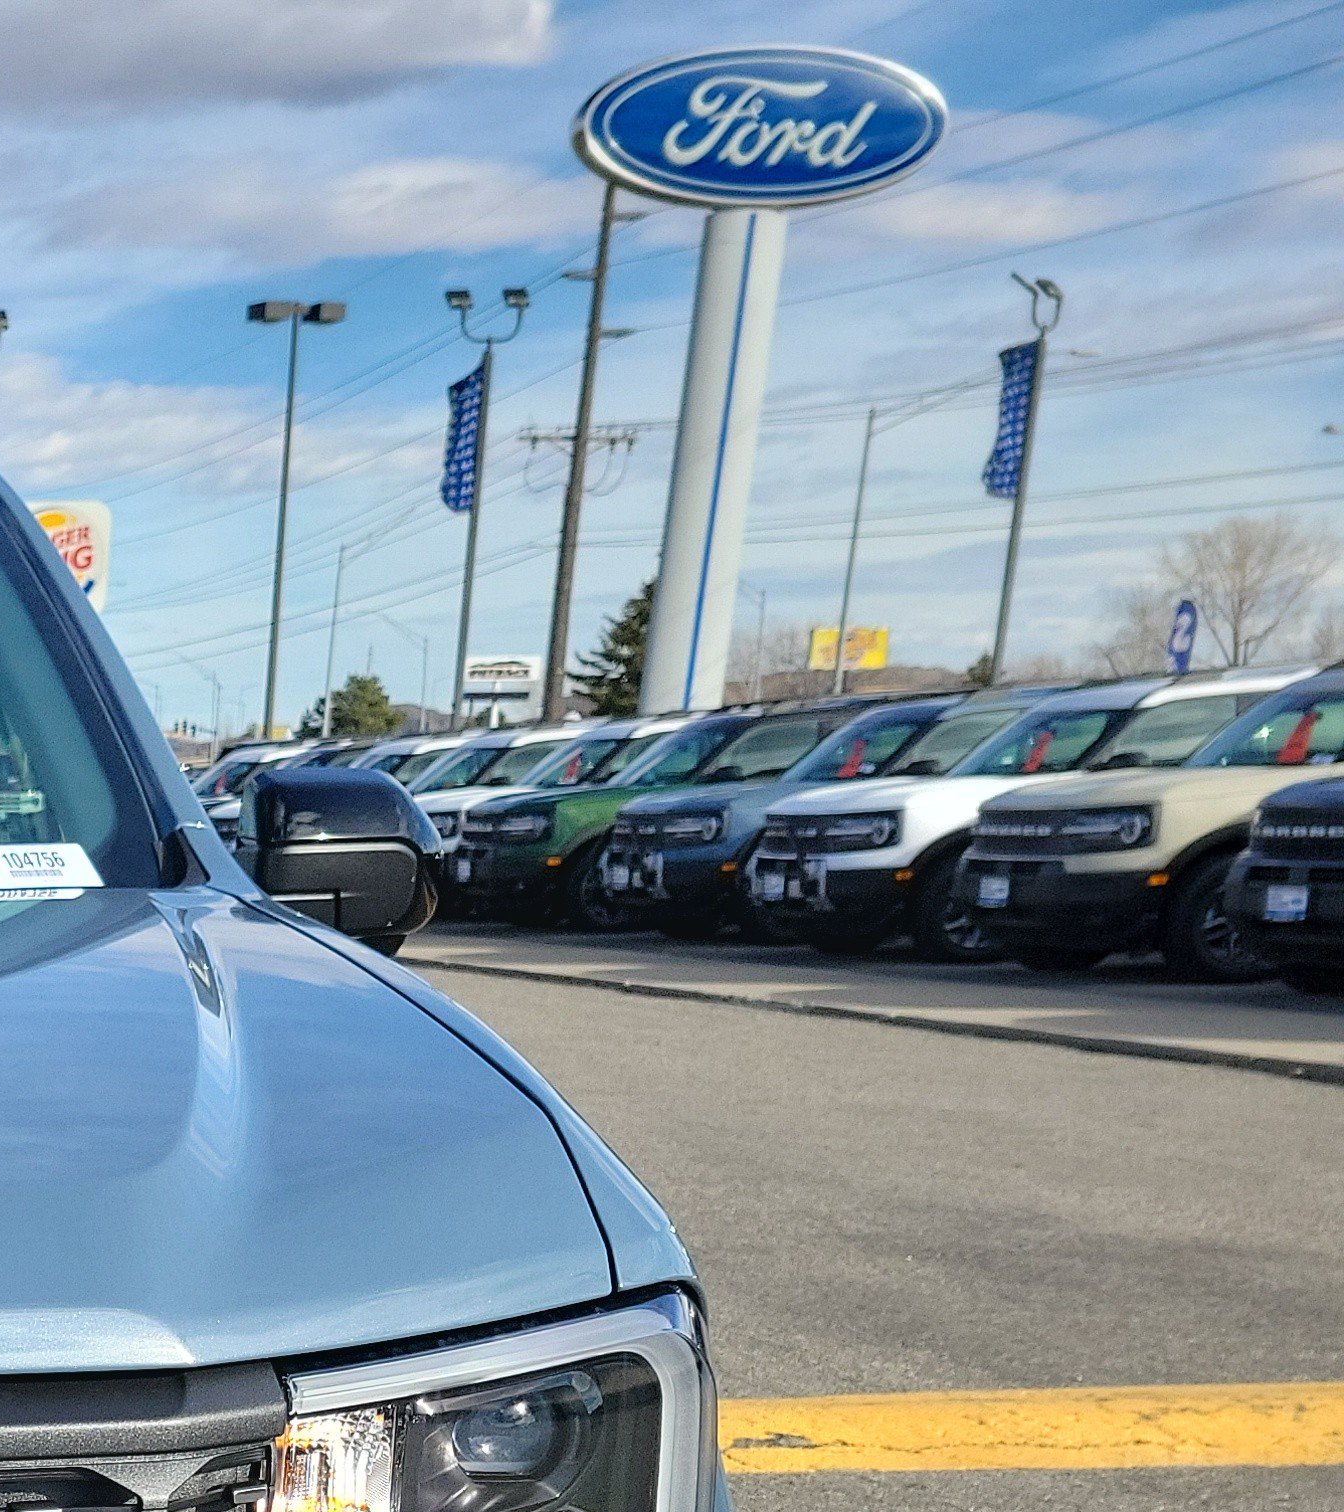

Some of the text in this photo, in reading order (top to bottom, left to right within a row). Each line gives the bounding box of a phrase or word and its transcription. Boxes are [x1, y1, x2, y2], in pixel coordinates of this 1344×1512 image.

[662, 74, 879, 168] Ford
[50, 526, 90, 549] GER
[1, 851, 66, 869] 104756
